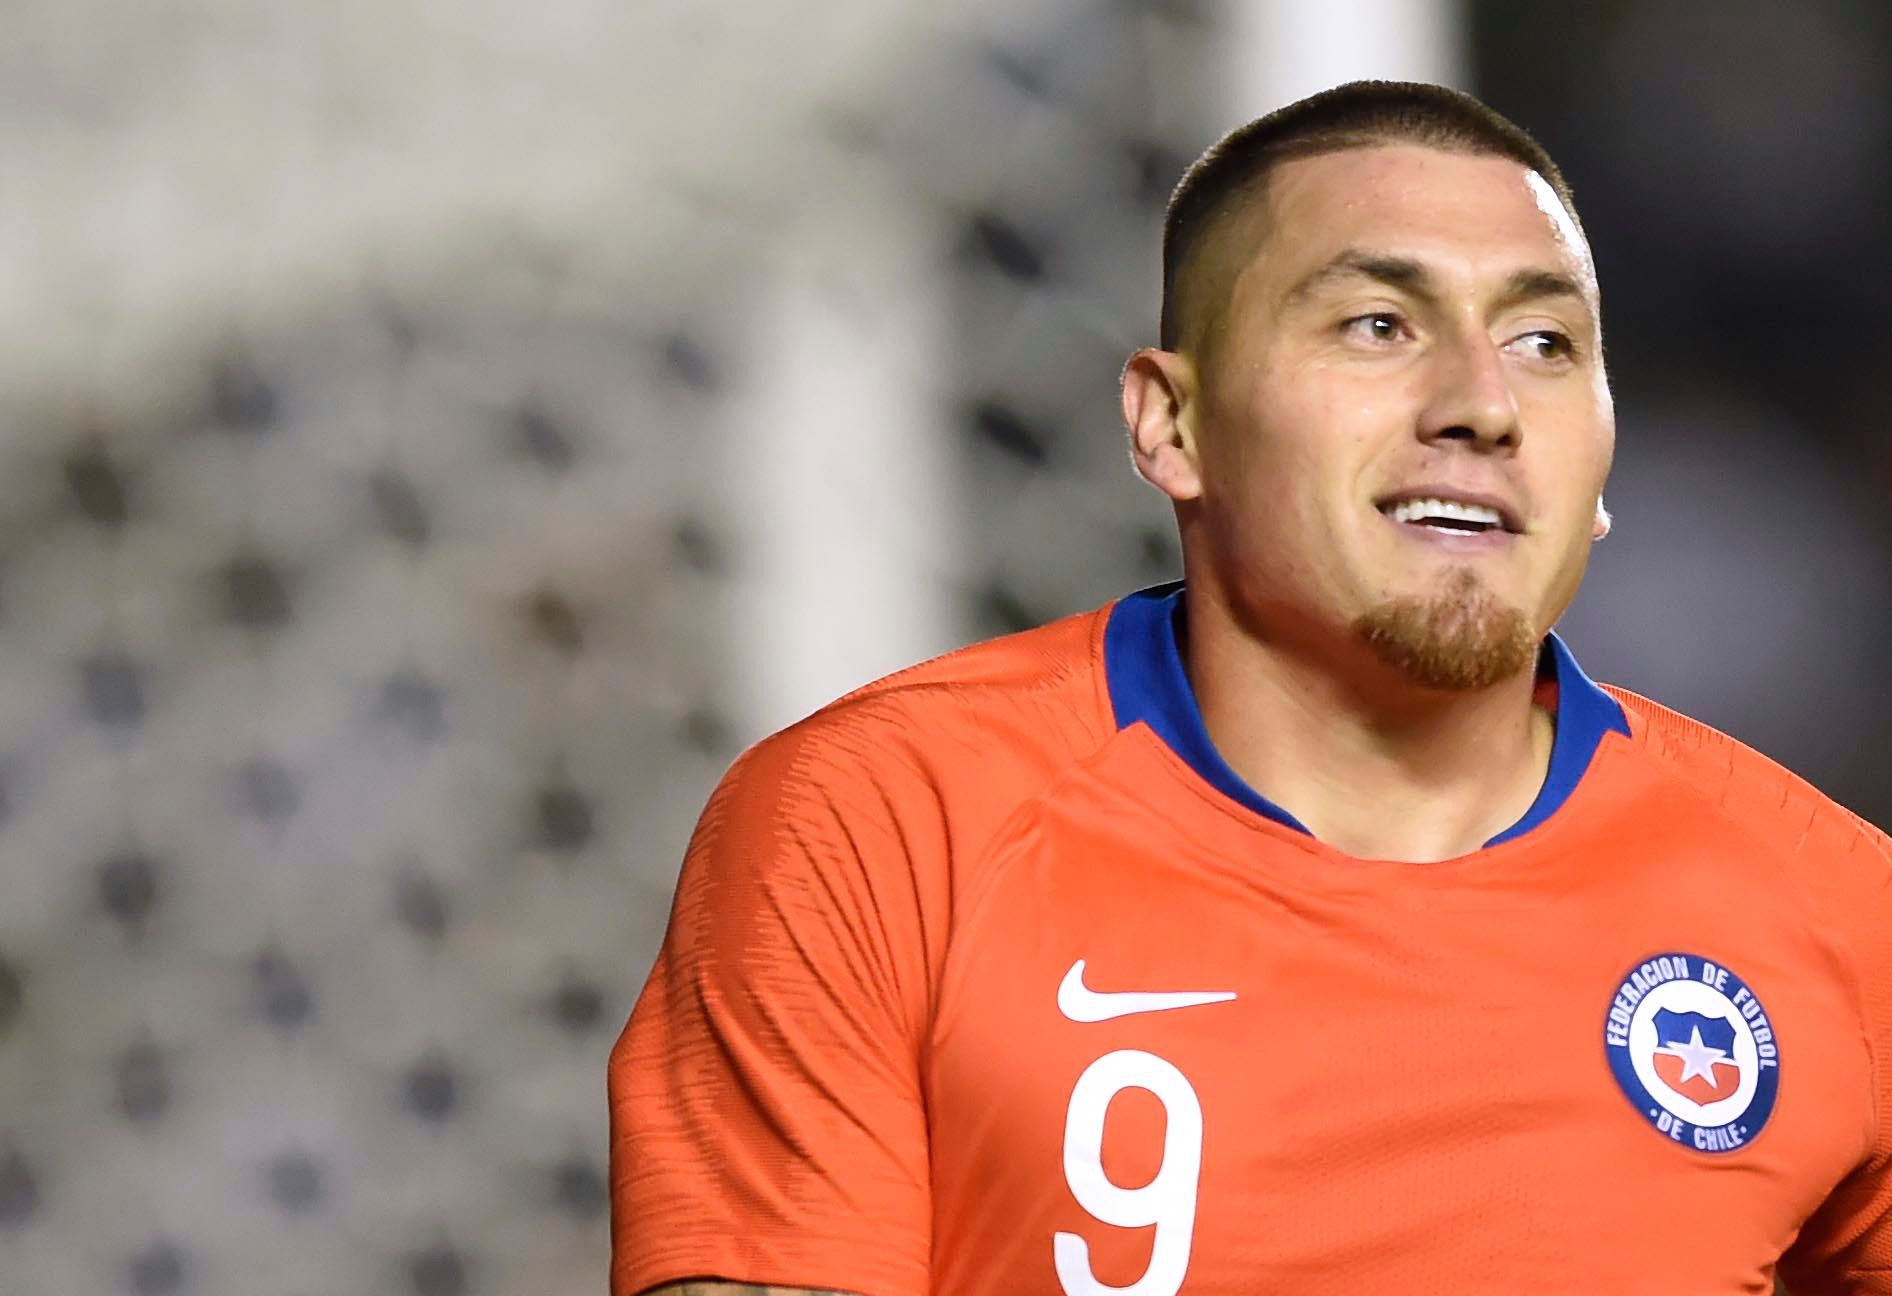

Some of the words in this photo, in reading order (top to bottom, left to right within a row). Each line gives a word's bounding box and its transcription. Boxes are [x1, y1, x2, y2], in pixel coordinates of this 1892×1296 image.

[1606, 956, 1690, 1047] FEDERACION
[1702, 962, 1729, 991] DE
[1733, 987, 1778, 1071] FUTBOL
[1656, 1110, 1685, 1141] DE
[1693, 1122, 1744, 1151] CHILE
